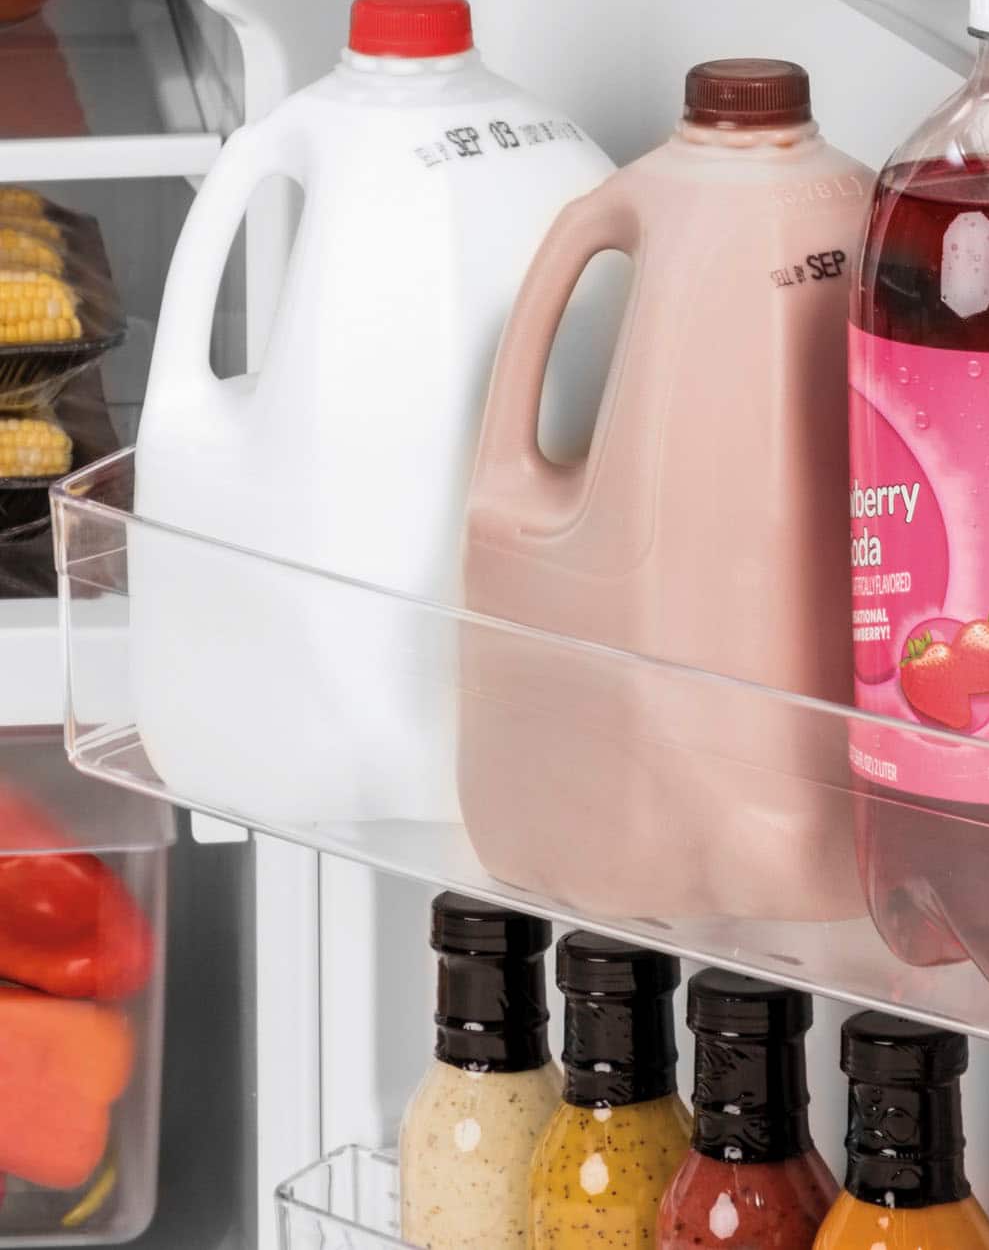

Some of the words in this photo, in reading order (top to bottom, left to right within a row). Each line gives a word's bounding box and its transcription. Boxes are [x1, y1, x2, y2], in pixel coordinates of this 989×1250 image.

[445, 126, 484, 158] SEP
[488, 120, 521, 150] 03
[806, 249, 847, 281] SEP
[850, 478, 921, 524] berry
[850, 526, 882, 568] oda
